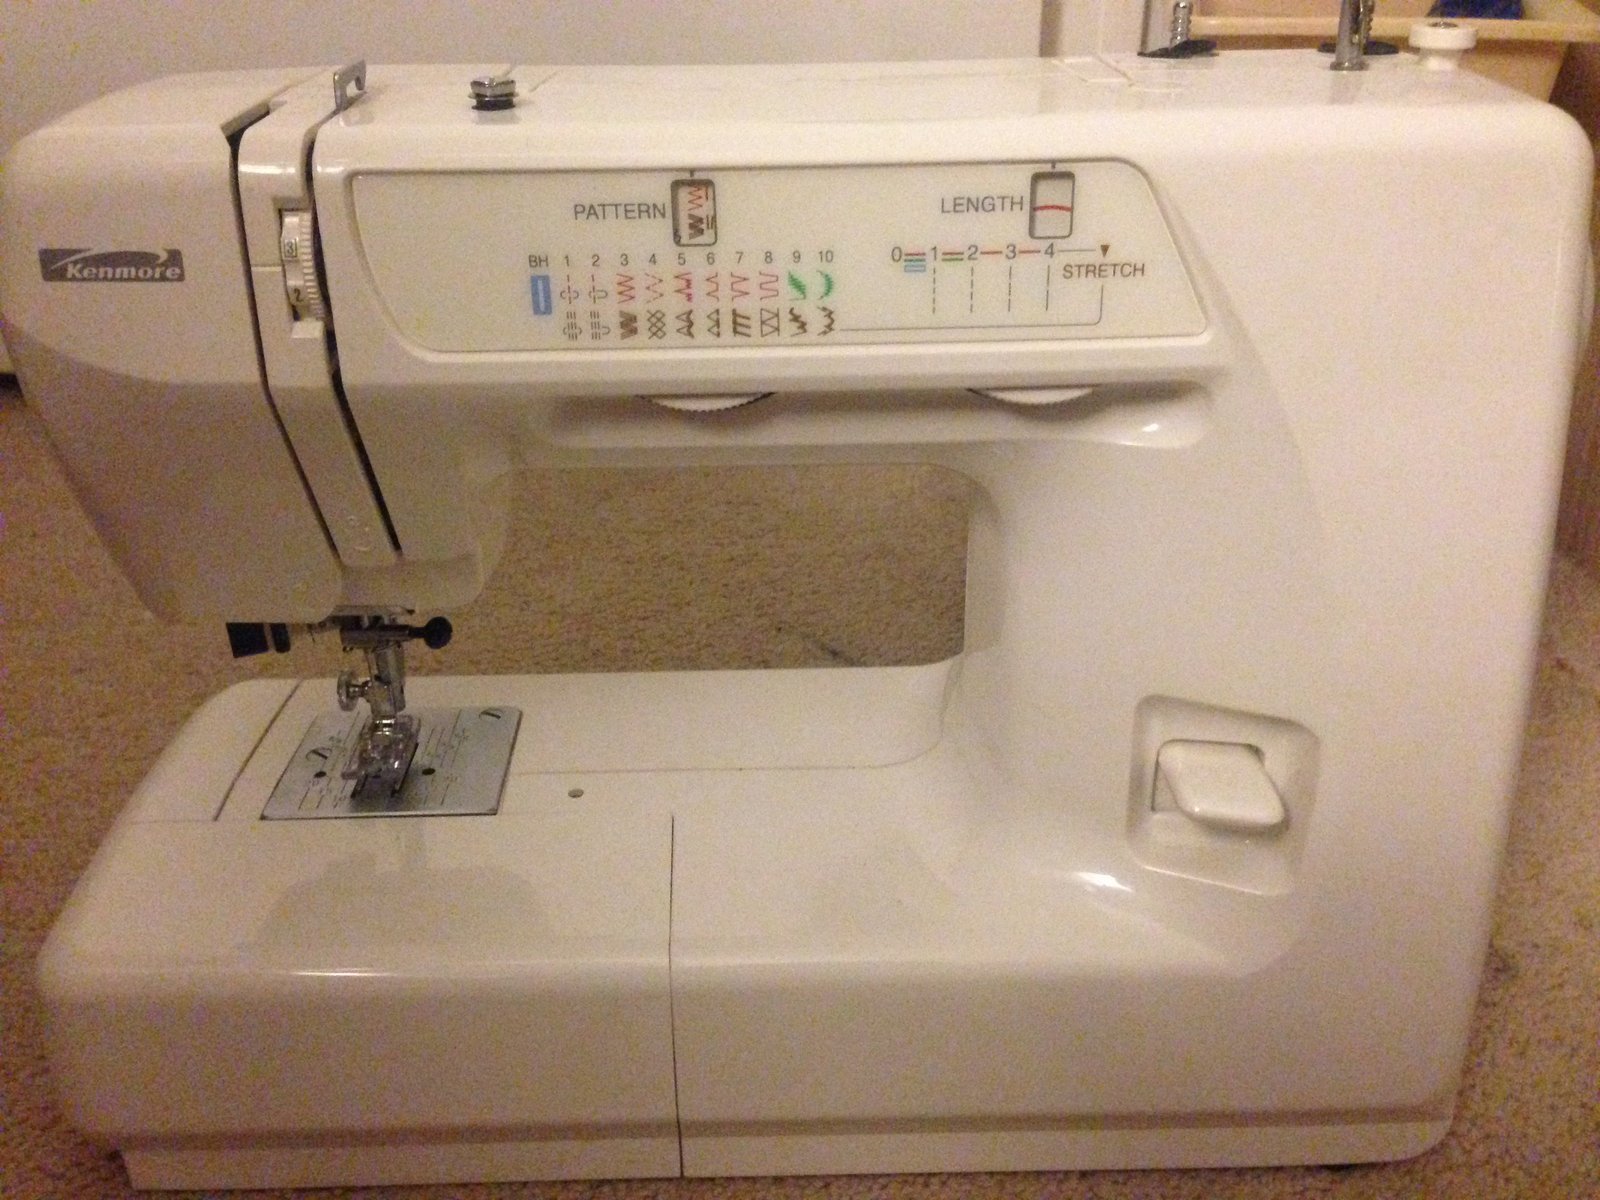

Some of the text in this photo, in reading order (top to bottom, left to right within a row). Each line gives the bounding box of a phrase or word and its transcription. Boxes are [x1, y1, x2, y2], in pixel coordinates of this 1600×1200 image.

[573, 203, 666, 221] PATTERN
[940, 195, 1024, 214] LENGTH
[528, 251, 834, 268] BH 1 2 3 4 5 6 7 8 9 10
[891, 243, 1055, 262] 0 1 2 3 4
[66, 264, 182, 280] Kenmore
[1062, 263, 1145, 279] STRETCH
